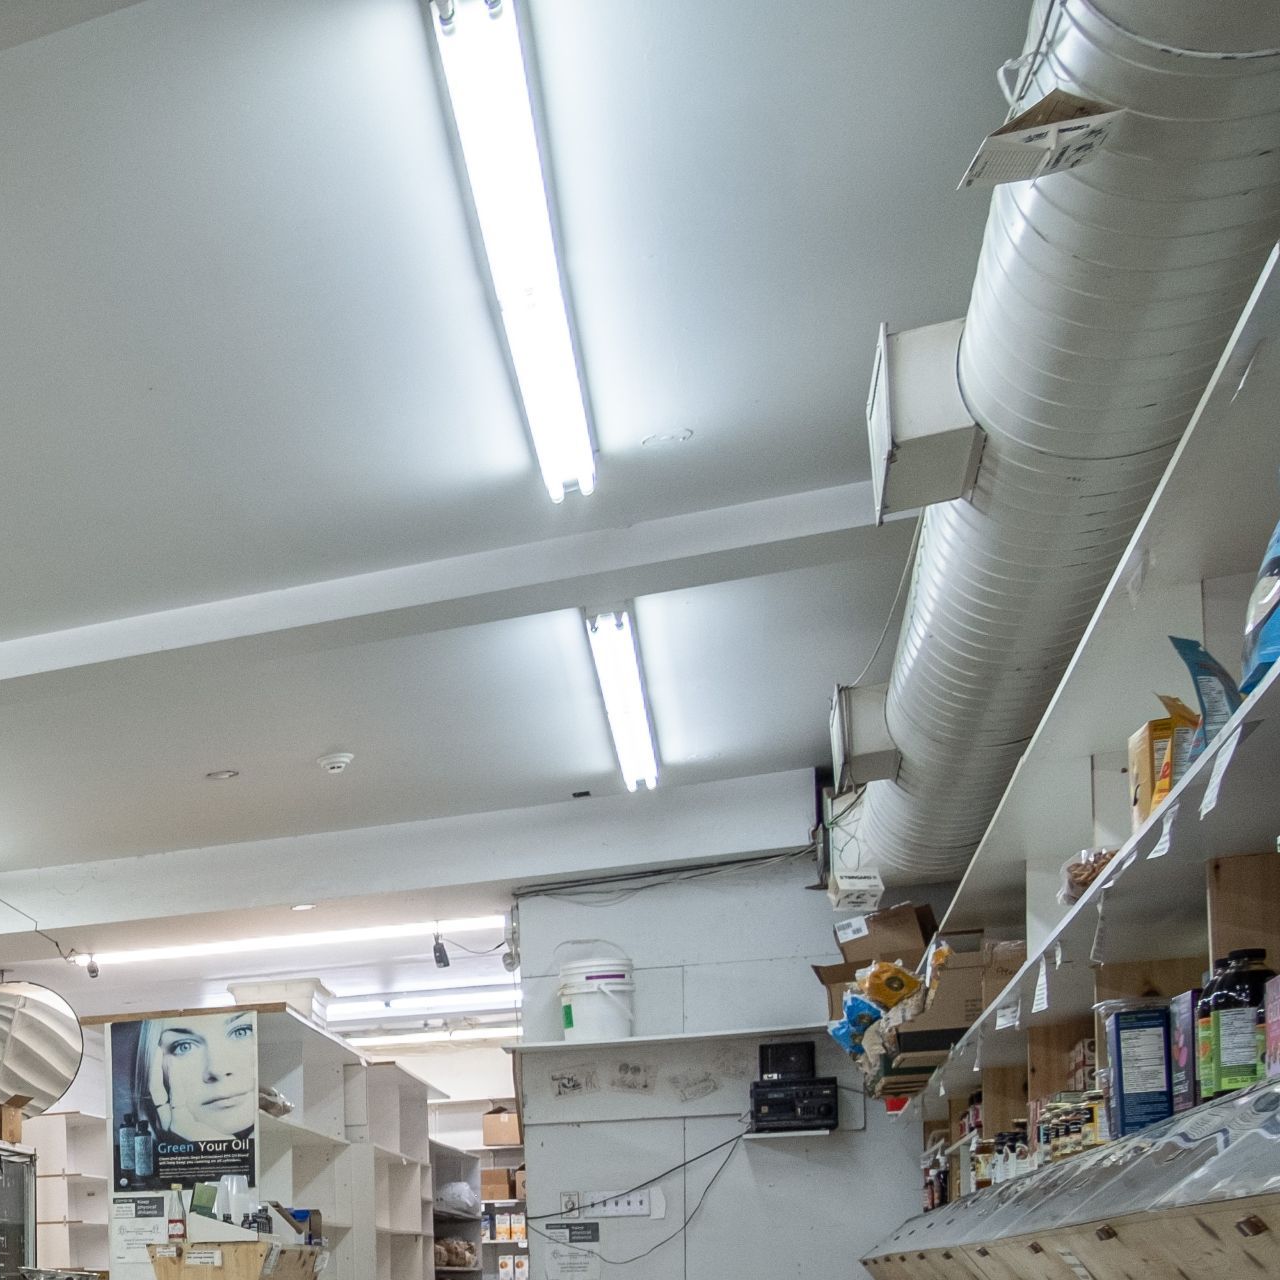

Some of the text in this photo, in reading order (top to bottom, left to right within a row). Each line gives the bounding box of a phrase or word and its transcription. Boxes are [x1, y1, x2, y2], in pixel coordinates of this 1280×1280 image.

[157, 1138, 250, 1154] Green Your Oil
